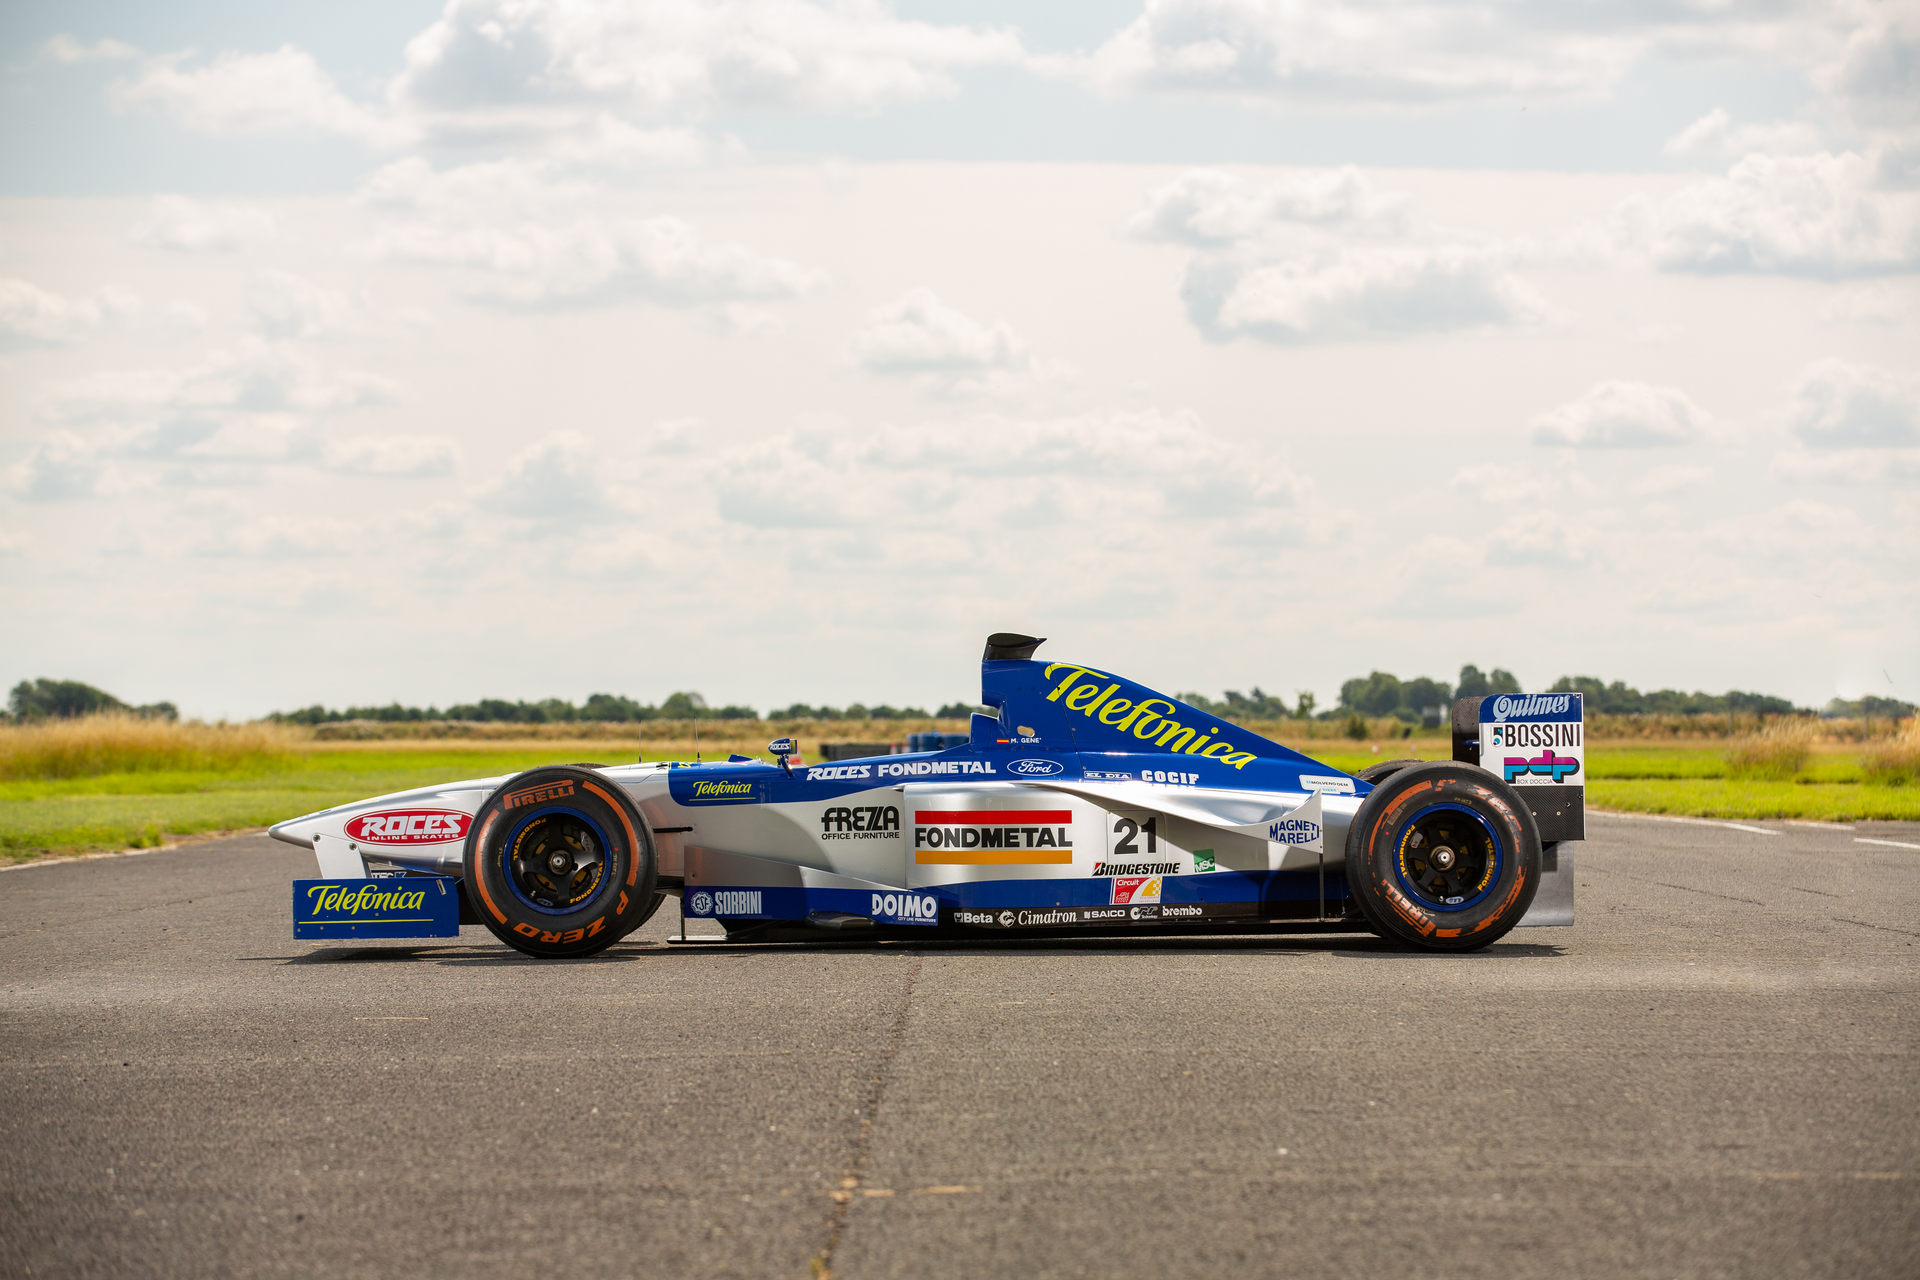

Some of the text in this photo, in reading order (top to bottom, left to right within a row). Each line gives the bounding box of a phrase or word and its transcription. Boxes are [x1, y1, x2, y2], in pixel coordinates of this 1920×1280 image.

[1493, 695, 1570, 722] Quilmes
[1505, 724, 1580, 747] BOSSINI
[806, 761, 996, 781] ROCES FONDMETAL
[1017, 760, 1052, 774] Ford
[1141, 769, 1199, 785] COCIF
[503, 779, 575, 810] PIRELLI
[360, 814, 463, 837] ROCES
[1113, 816, 1157, 854] 21
[1269, 819, 1320, 834] MAGNETI
[821, 831, 900, 841] OFFICE FURNITURE
[915, 827, 1073, 848] FONDMETAL
[1269, 829, 1320, 844] MARELLI
[1092, 862, 1181, 876] BRIDGESTONE
[1117, 878, 1140, 886] Circuit
[715, 891, 762, 915] SORBINI
[872, 893, 937, 917] DOIMO
[513, 890, 629, 944] P ZERO
[964, 912, 993, 923] Beta
[1018, 910, 1077, 925] Cimatron
[1091, 909, 1126, 918] SAICO
[1162, 905, 1202, 917] brembo
